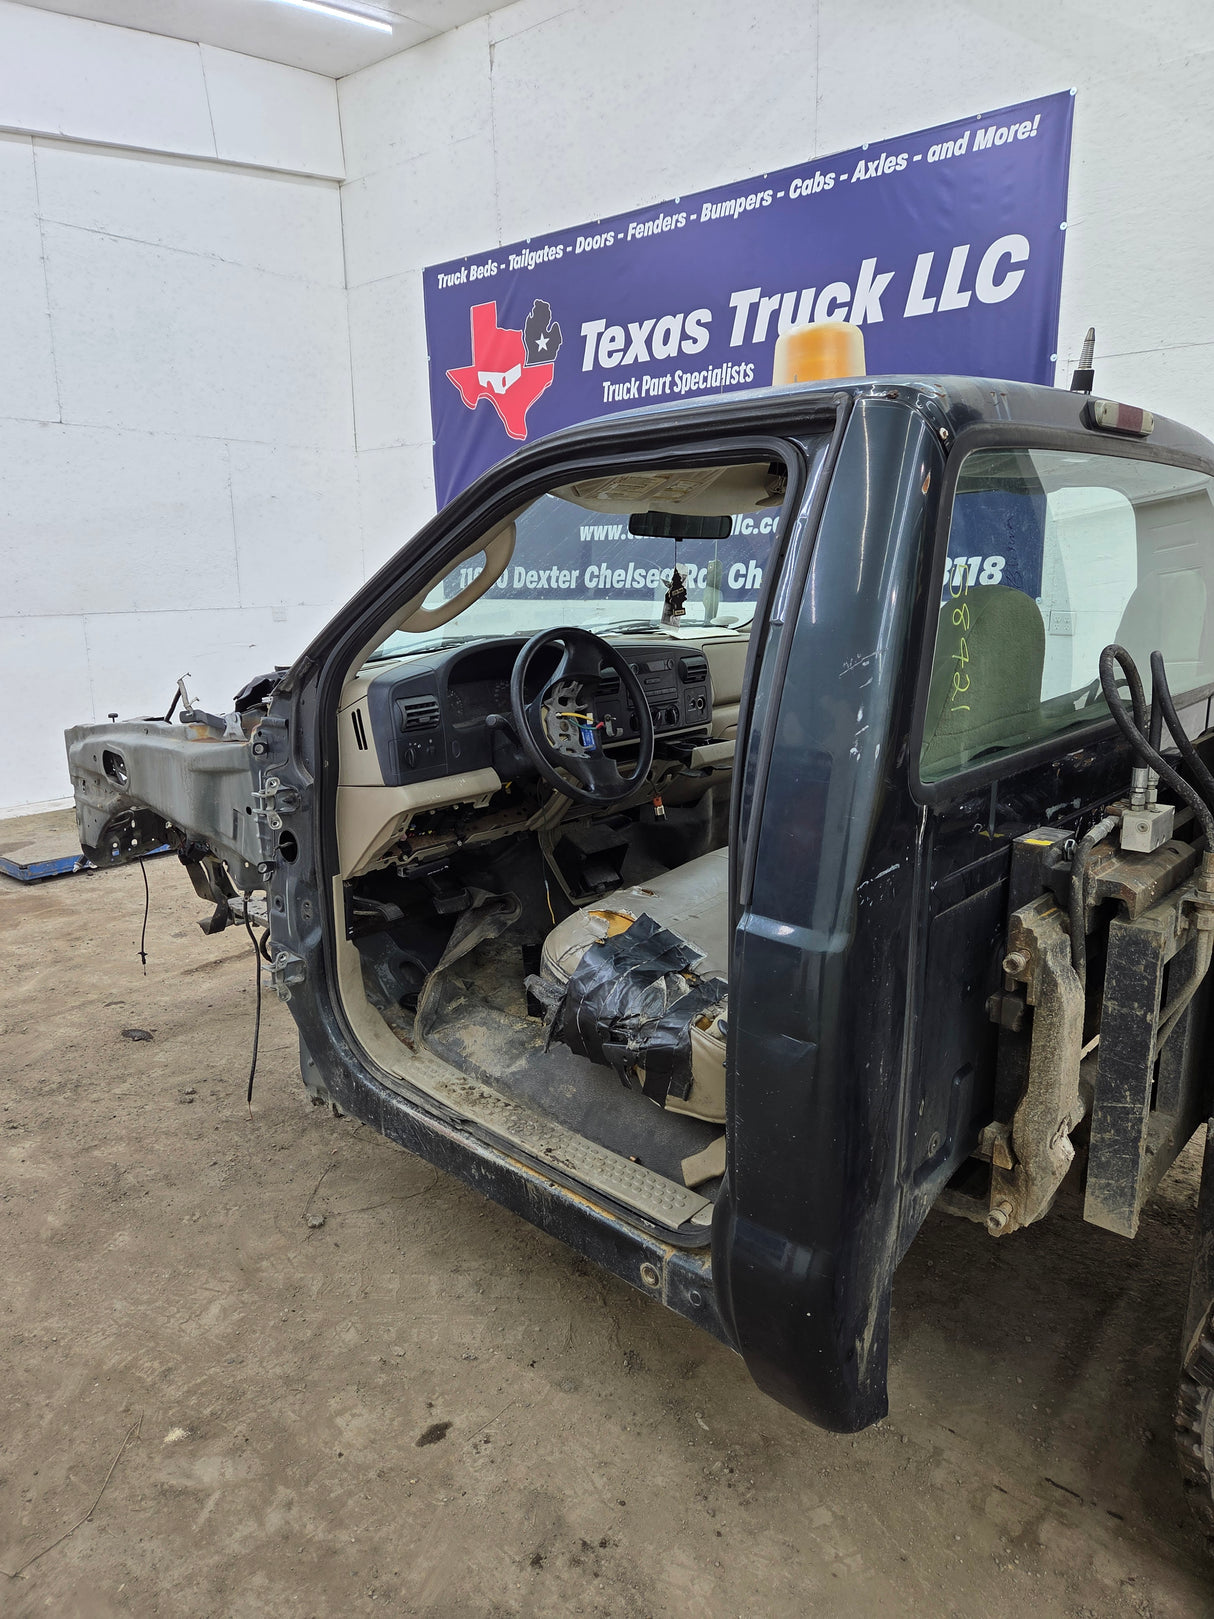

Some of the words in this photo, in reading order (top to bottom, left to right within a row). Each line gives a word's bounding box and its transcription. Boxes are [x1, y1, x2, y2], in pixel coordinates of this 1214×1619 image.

[438, 267, 468, 289] Truck
[469, 259, 498, 281] Beds
[508, 244, 564, 270] Tailgates
[575, 231, 615, 254] Doors
[627, 213, 687, 241] Fenders
[700, 190, 773, 222] Bumpers
[789, 171, 836, 199] Cabs
[851, 153, 908, 183] Axles
[927, 130, 971, 163] and
[972, 114, 1041, 152] More!
[581, 309, 712, 372] Texas
[729, 257, 896, 347] Truck
[903, 234, 1030, 318] LLC
[602, 377, 640, 403] Truck
[641, 372, 672, 397] Part
[673, 362, 755, 393] Specialists
[513, 565, 579, 589] Dexter
[949, 564, 971, 712] 58421
